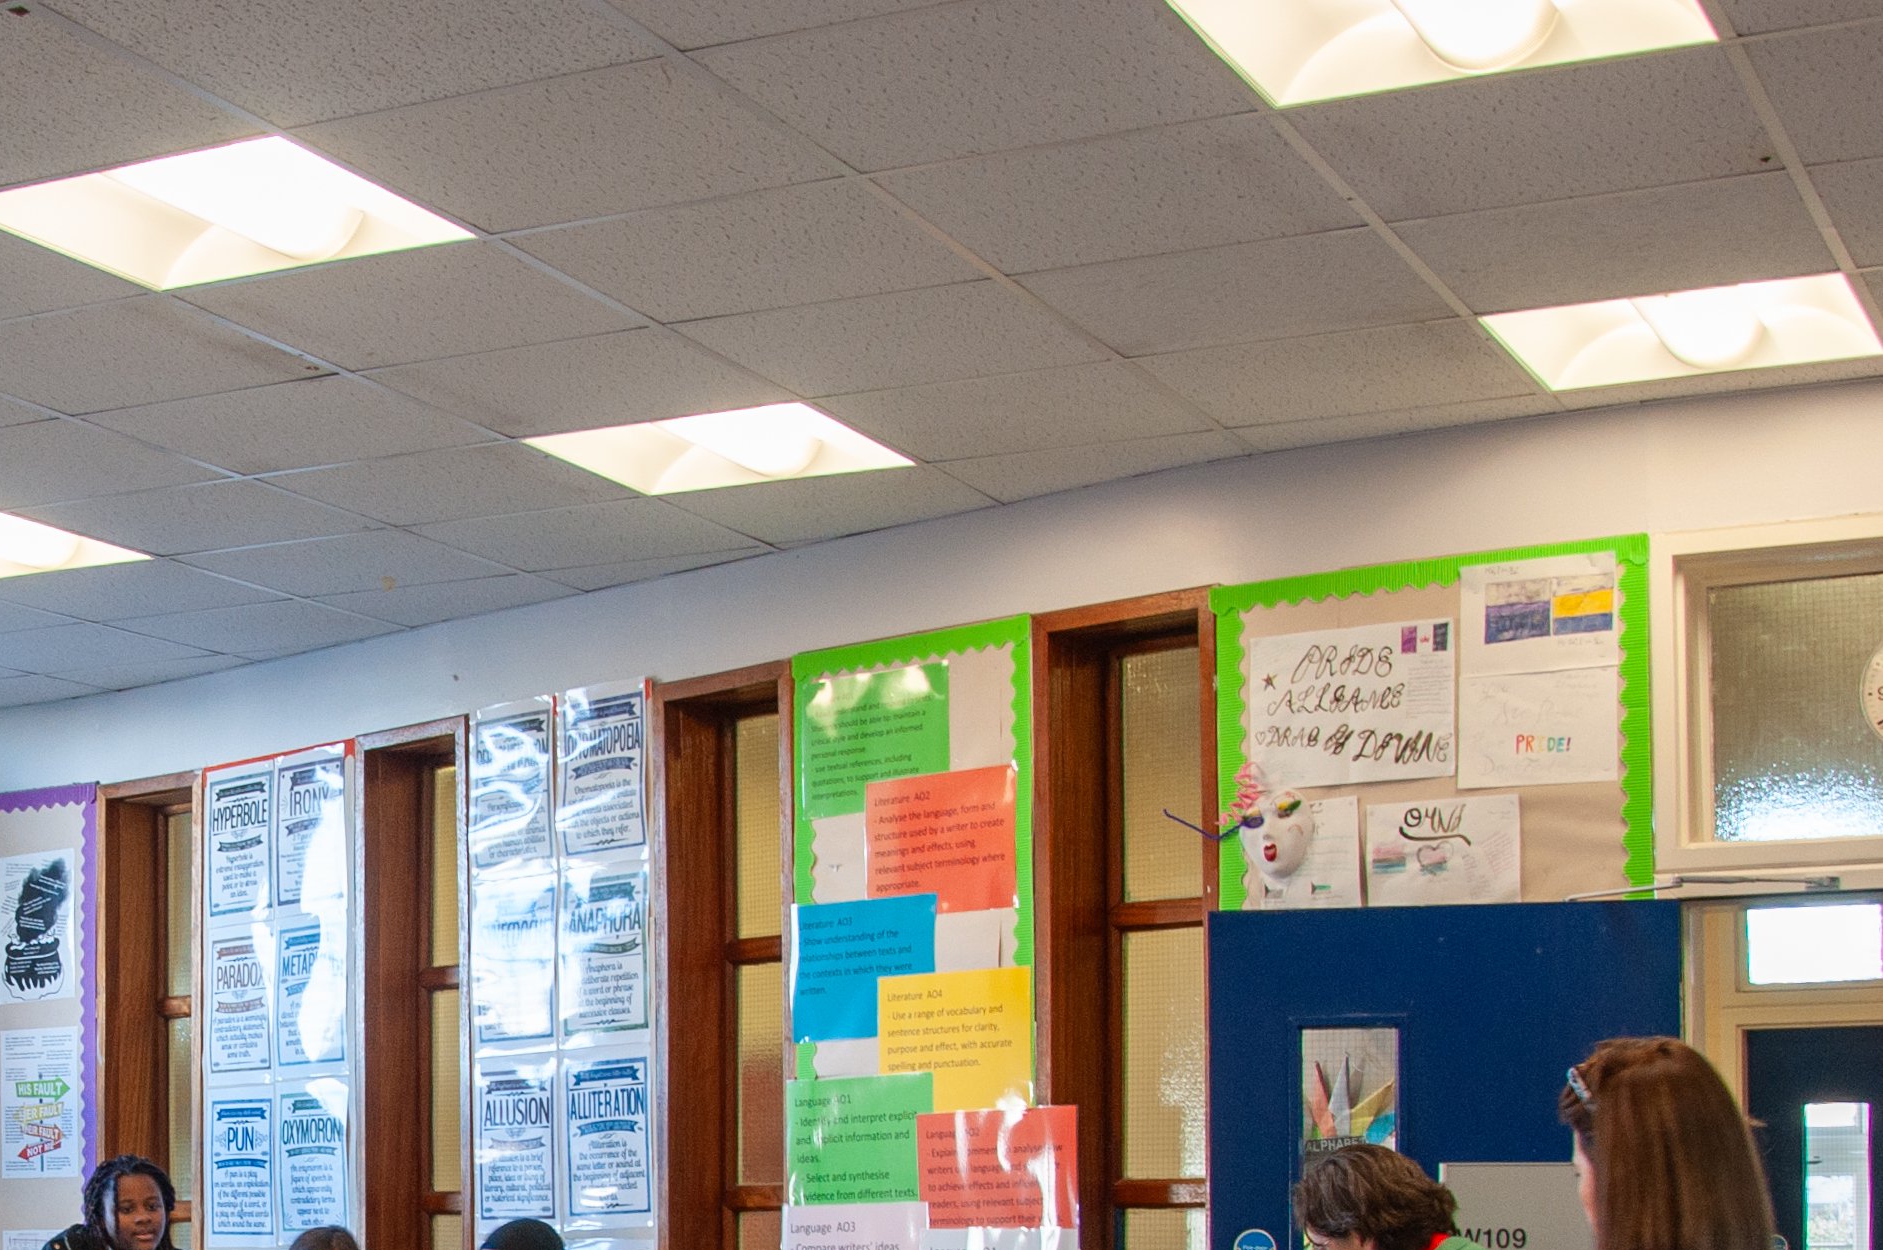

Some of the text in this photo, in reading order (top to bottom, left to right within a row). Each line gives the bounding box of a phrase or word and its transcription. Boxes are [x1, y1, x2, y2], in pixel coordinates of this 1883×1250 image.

[1516, 734, 1571, 754] PRIDE!
[213, 799, 267, 832] HYPERBOLE
[888, 989, 942, 1002] Literature AO4
[892, 1012, 905, 1021] Use
[914, 1010, 934, 1020] range
[937, 1008, 944, 1016] of
[947, 1006, 986, 1016] vocabulary
[989, 1005, 1003, 1013] and
[888, 1028, 920, 1037] sentence
[922, 1025, 960, 1035] structures
[962, 1023, 972, 1032] for
[888, 1046, 917, 1056] purpose
[920, 1043, 933, 1052] and
[961, 1040, 977, 1049] with
[980, 1039, 1012, 1048] accurate
[918, 1061, 931, 1070] and
[34, 1080, 62, 1096] FAULT
[571, 1088, 644, 1120] ALLITERATION
[484, 1097, 549, 1127] ALLUSION
[851, 1113, 886, 1124] interpret
[283, 1117, 342, 1145] OXYMORON
[796, 1136, 811, 1145] and
[845, 1130, 892, 1142] information
[894, 1130, 909, 1139] and
[228, 1126, 254, 1152] PUN
[798, 1154, 821, 1164] ideas.
[806, 1170, 889, 1183] Select and synthesise
[806, 1188, 918, 1201] vidence from different texts.
[790, 1221, 856, 1235] Language AO3
